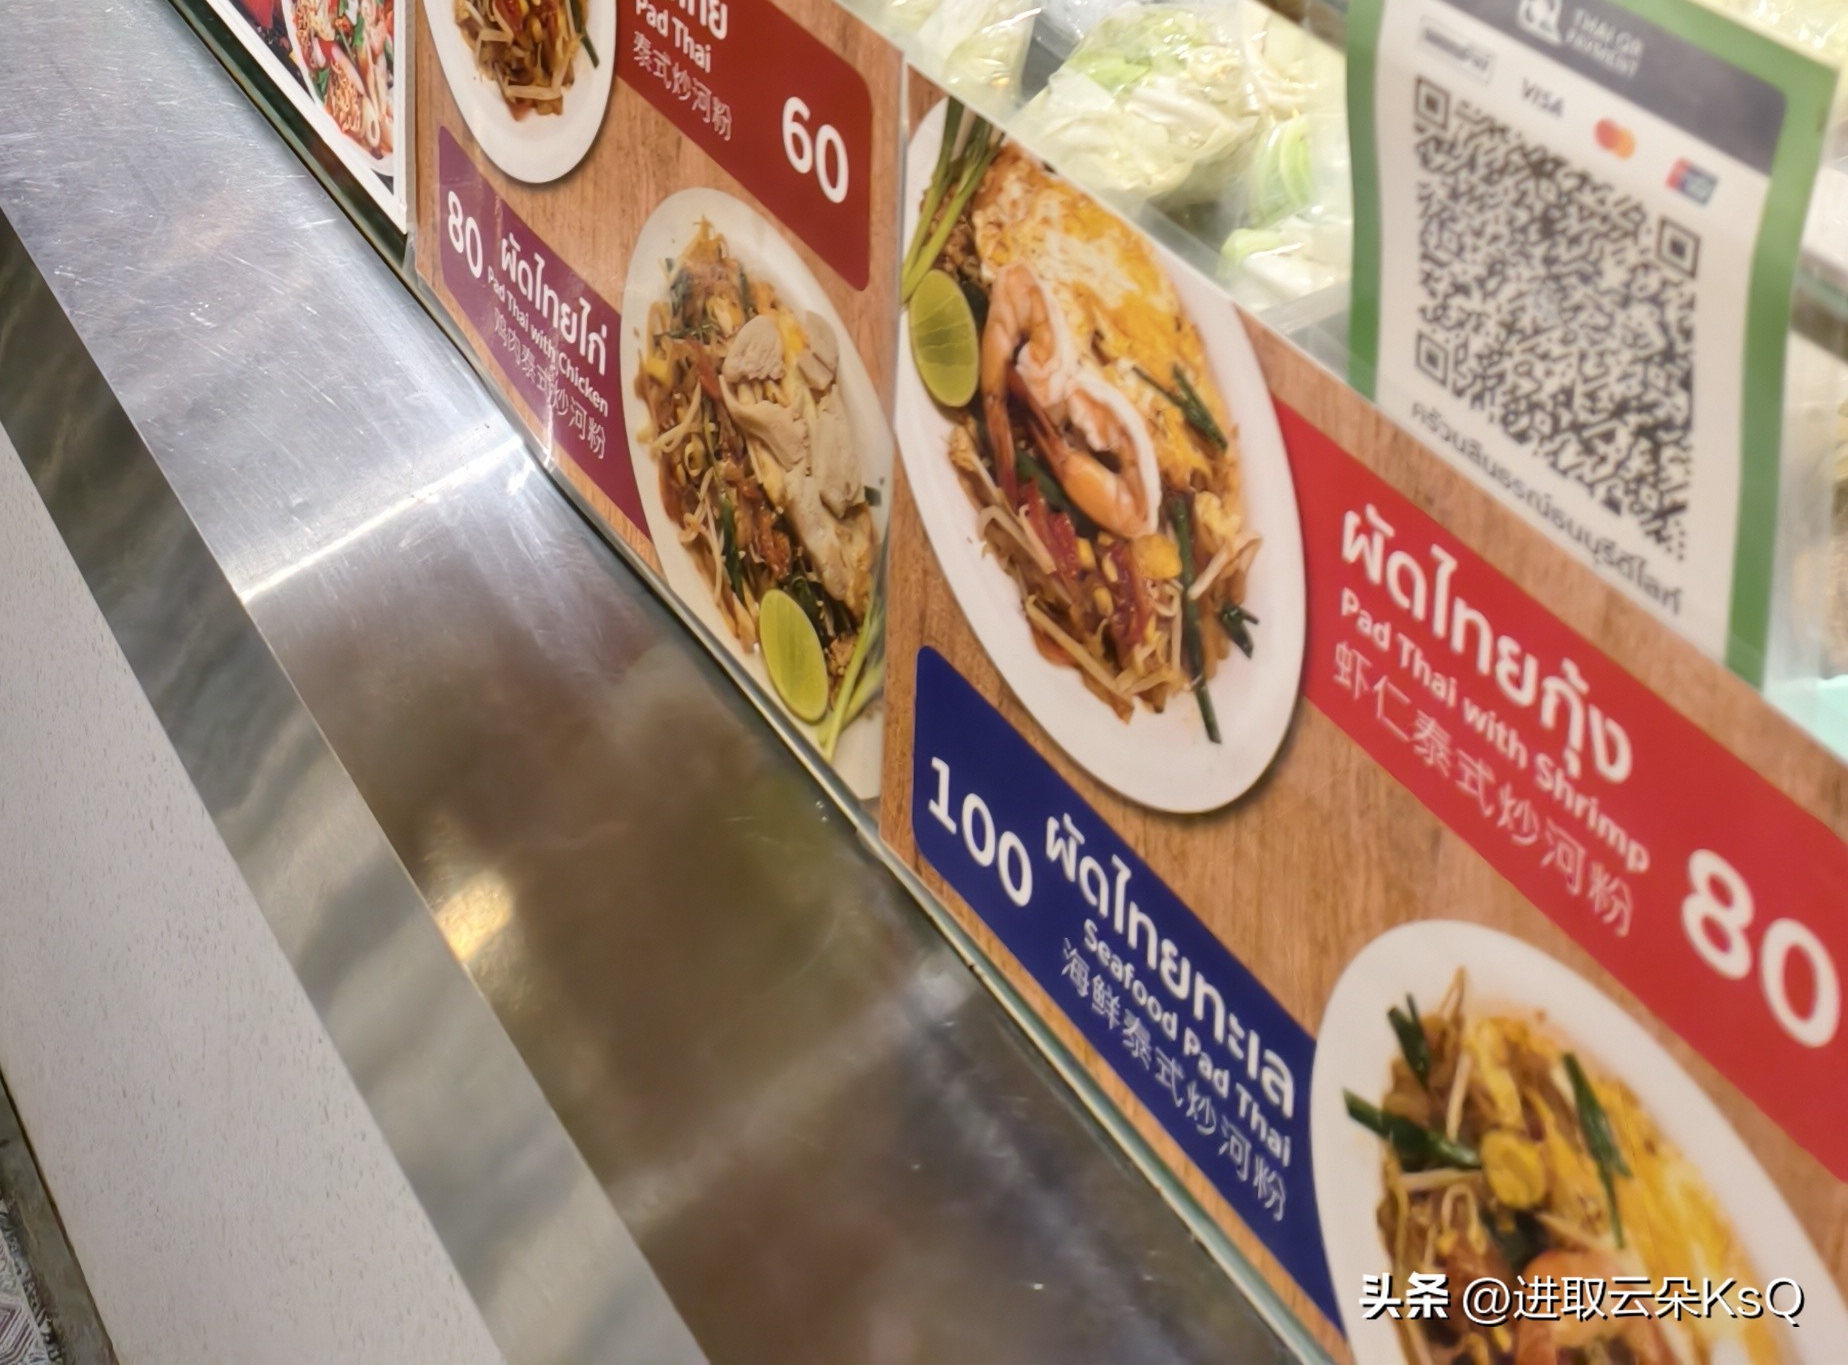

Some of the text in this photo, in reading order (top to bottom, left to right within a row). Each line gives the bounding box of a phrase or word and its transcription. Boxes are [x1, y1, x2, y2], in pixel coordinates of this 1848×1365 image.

[633, 30, 733, 142] 泰式炒河粉
[671, 16, 712, 73] Thai
[1521, 77, 1565, 117] VISA
[782, 96, 849, 204] 60
[447, 190, 484, 279] 80
[501, 232, 608, 376] ผัดไทยไก่
[487, 266, 609, 418] Pad Thai with Chicken
[1340, 503, 1634, 783] ผัดไทยกุ้ง
[1333, 639, 1635, 938] 虾仁泰式炒河粉
[1340, 587, 1652, 874] Pad Thai with Shrimp
[928, 756, 1034, 908] 100
[1045, 812, 1296, 1120] ผัดไทยทะเล
[1681, 848, 1843, 1048] 80
[1061, 937, 1289, 1222] 海鲜泰式炒河粉
[1083, 918, 1293, 1168] Seafood Pad Thai
